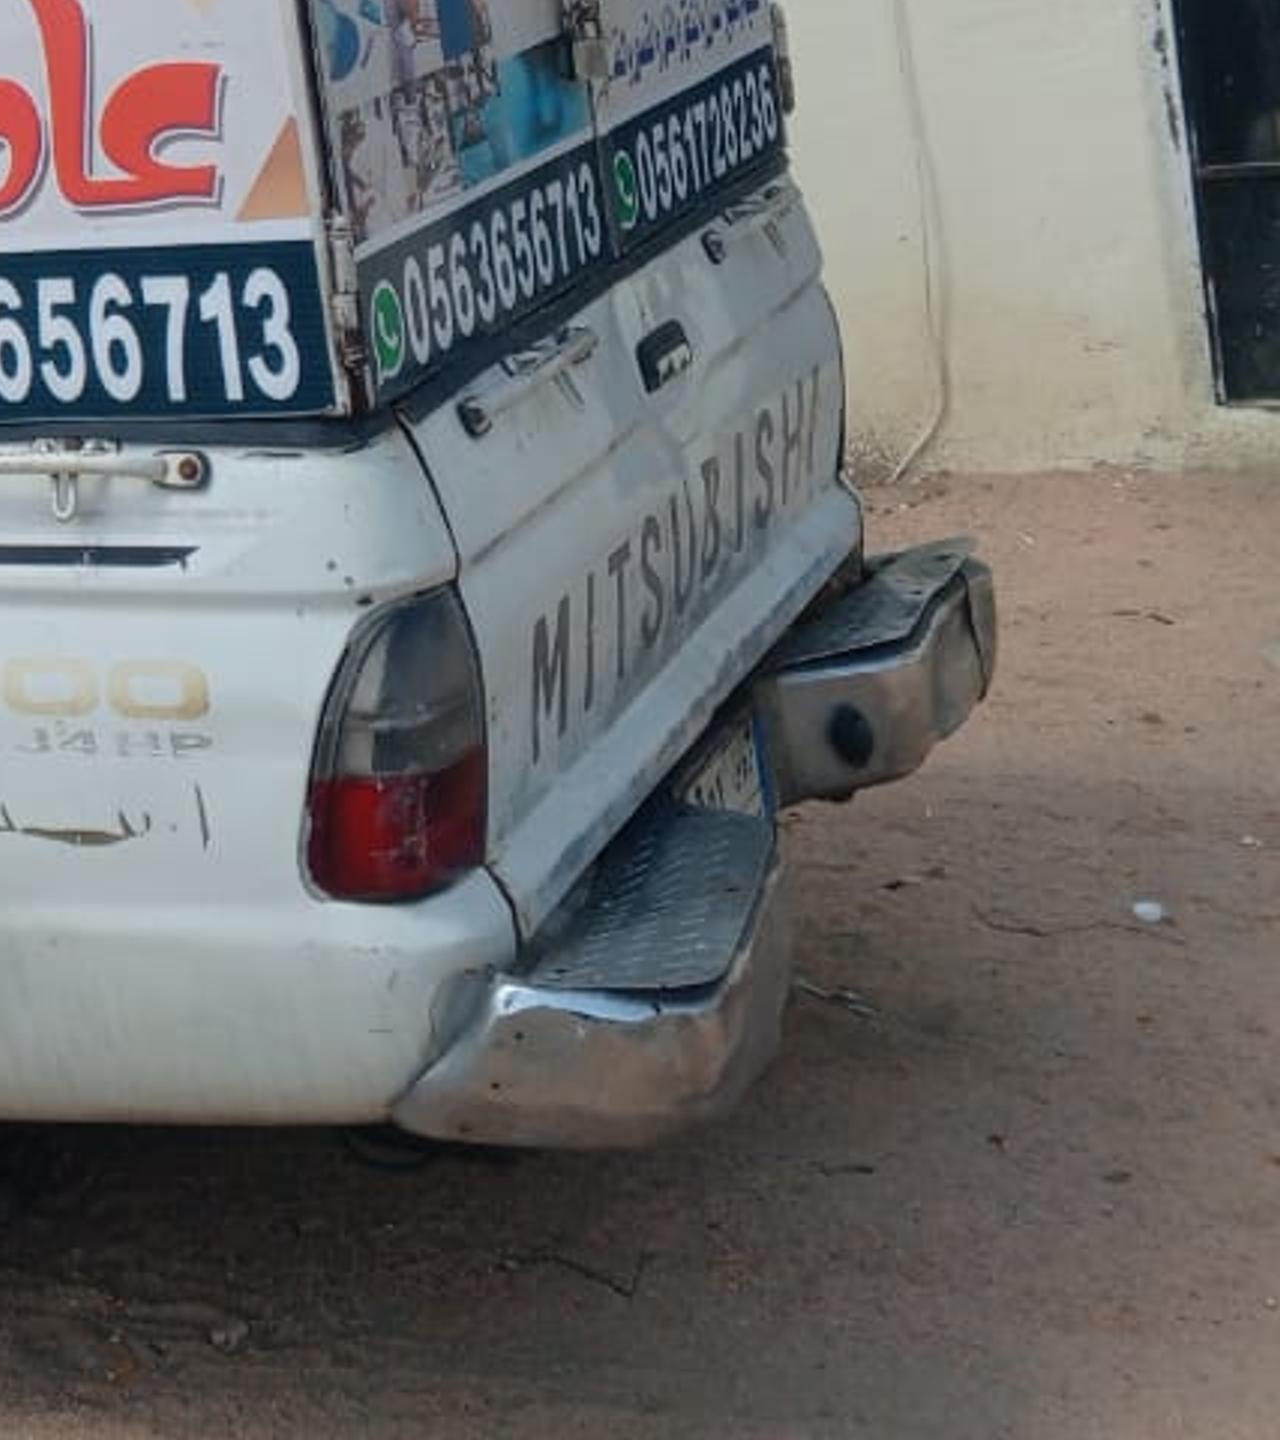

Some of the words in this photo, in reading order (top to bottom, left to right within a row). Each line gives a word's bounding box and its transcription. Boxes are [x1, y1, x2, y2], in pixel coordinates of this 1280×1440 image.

[636, 64, 779, 222] 0561728236
[403, 162, 604, 366] 0563656713
[530, 364, 822, 766] MITSUBISHI
